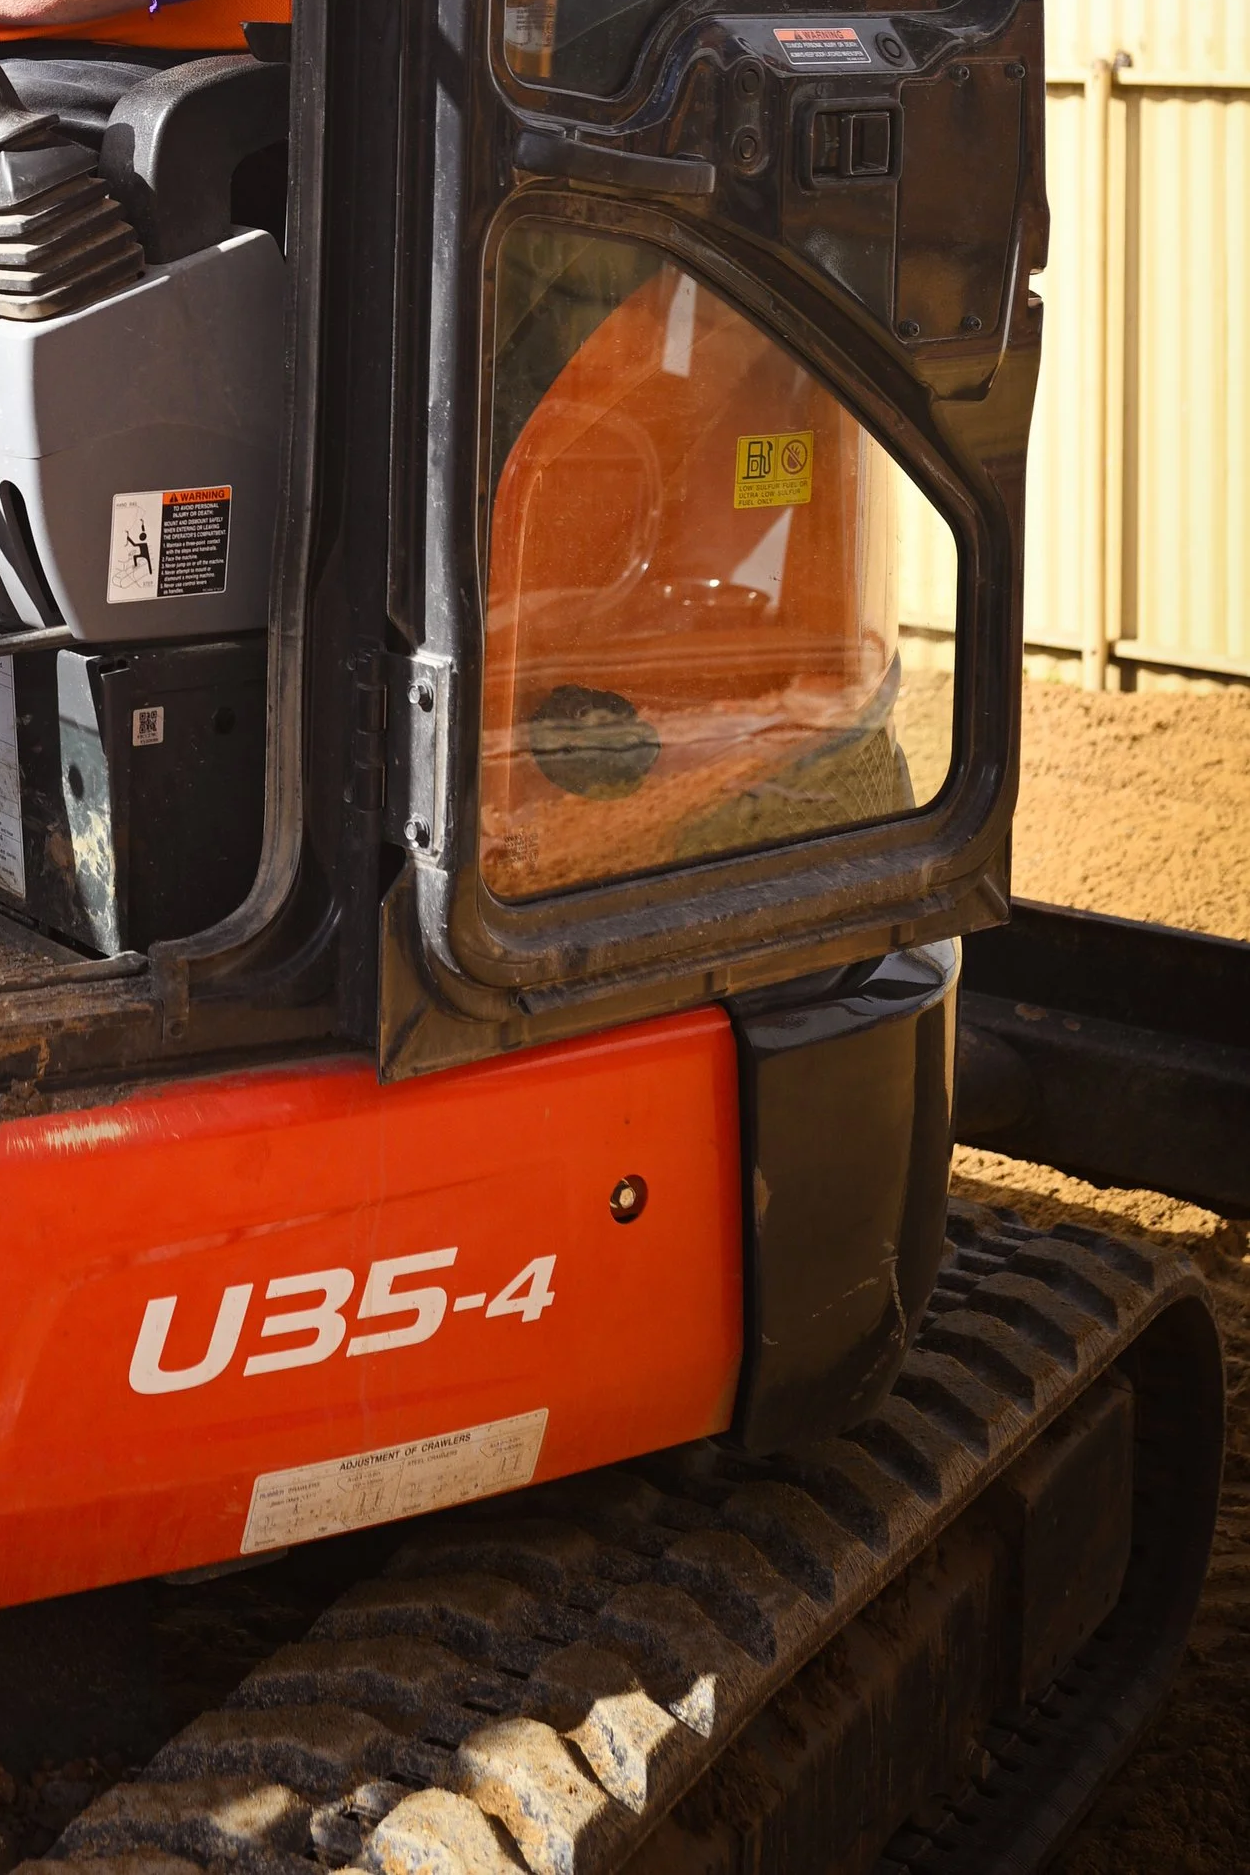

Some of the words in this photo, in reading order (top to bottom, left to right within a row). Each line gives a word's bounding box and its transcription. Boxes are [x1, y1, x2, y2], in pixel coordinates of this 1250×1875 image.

[803, 30, 844, 39] WARNING
[180, 490, 224, 502] WARNING
[128, 1246, 557, 1395] U35-4
[339, 1450, 400, 1471] ADJUSTMENT
[404, 1446, 418, 1457] OF
[421, 1433, 471, 1453] CRAWLERS
